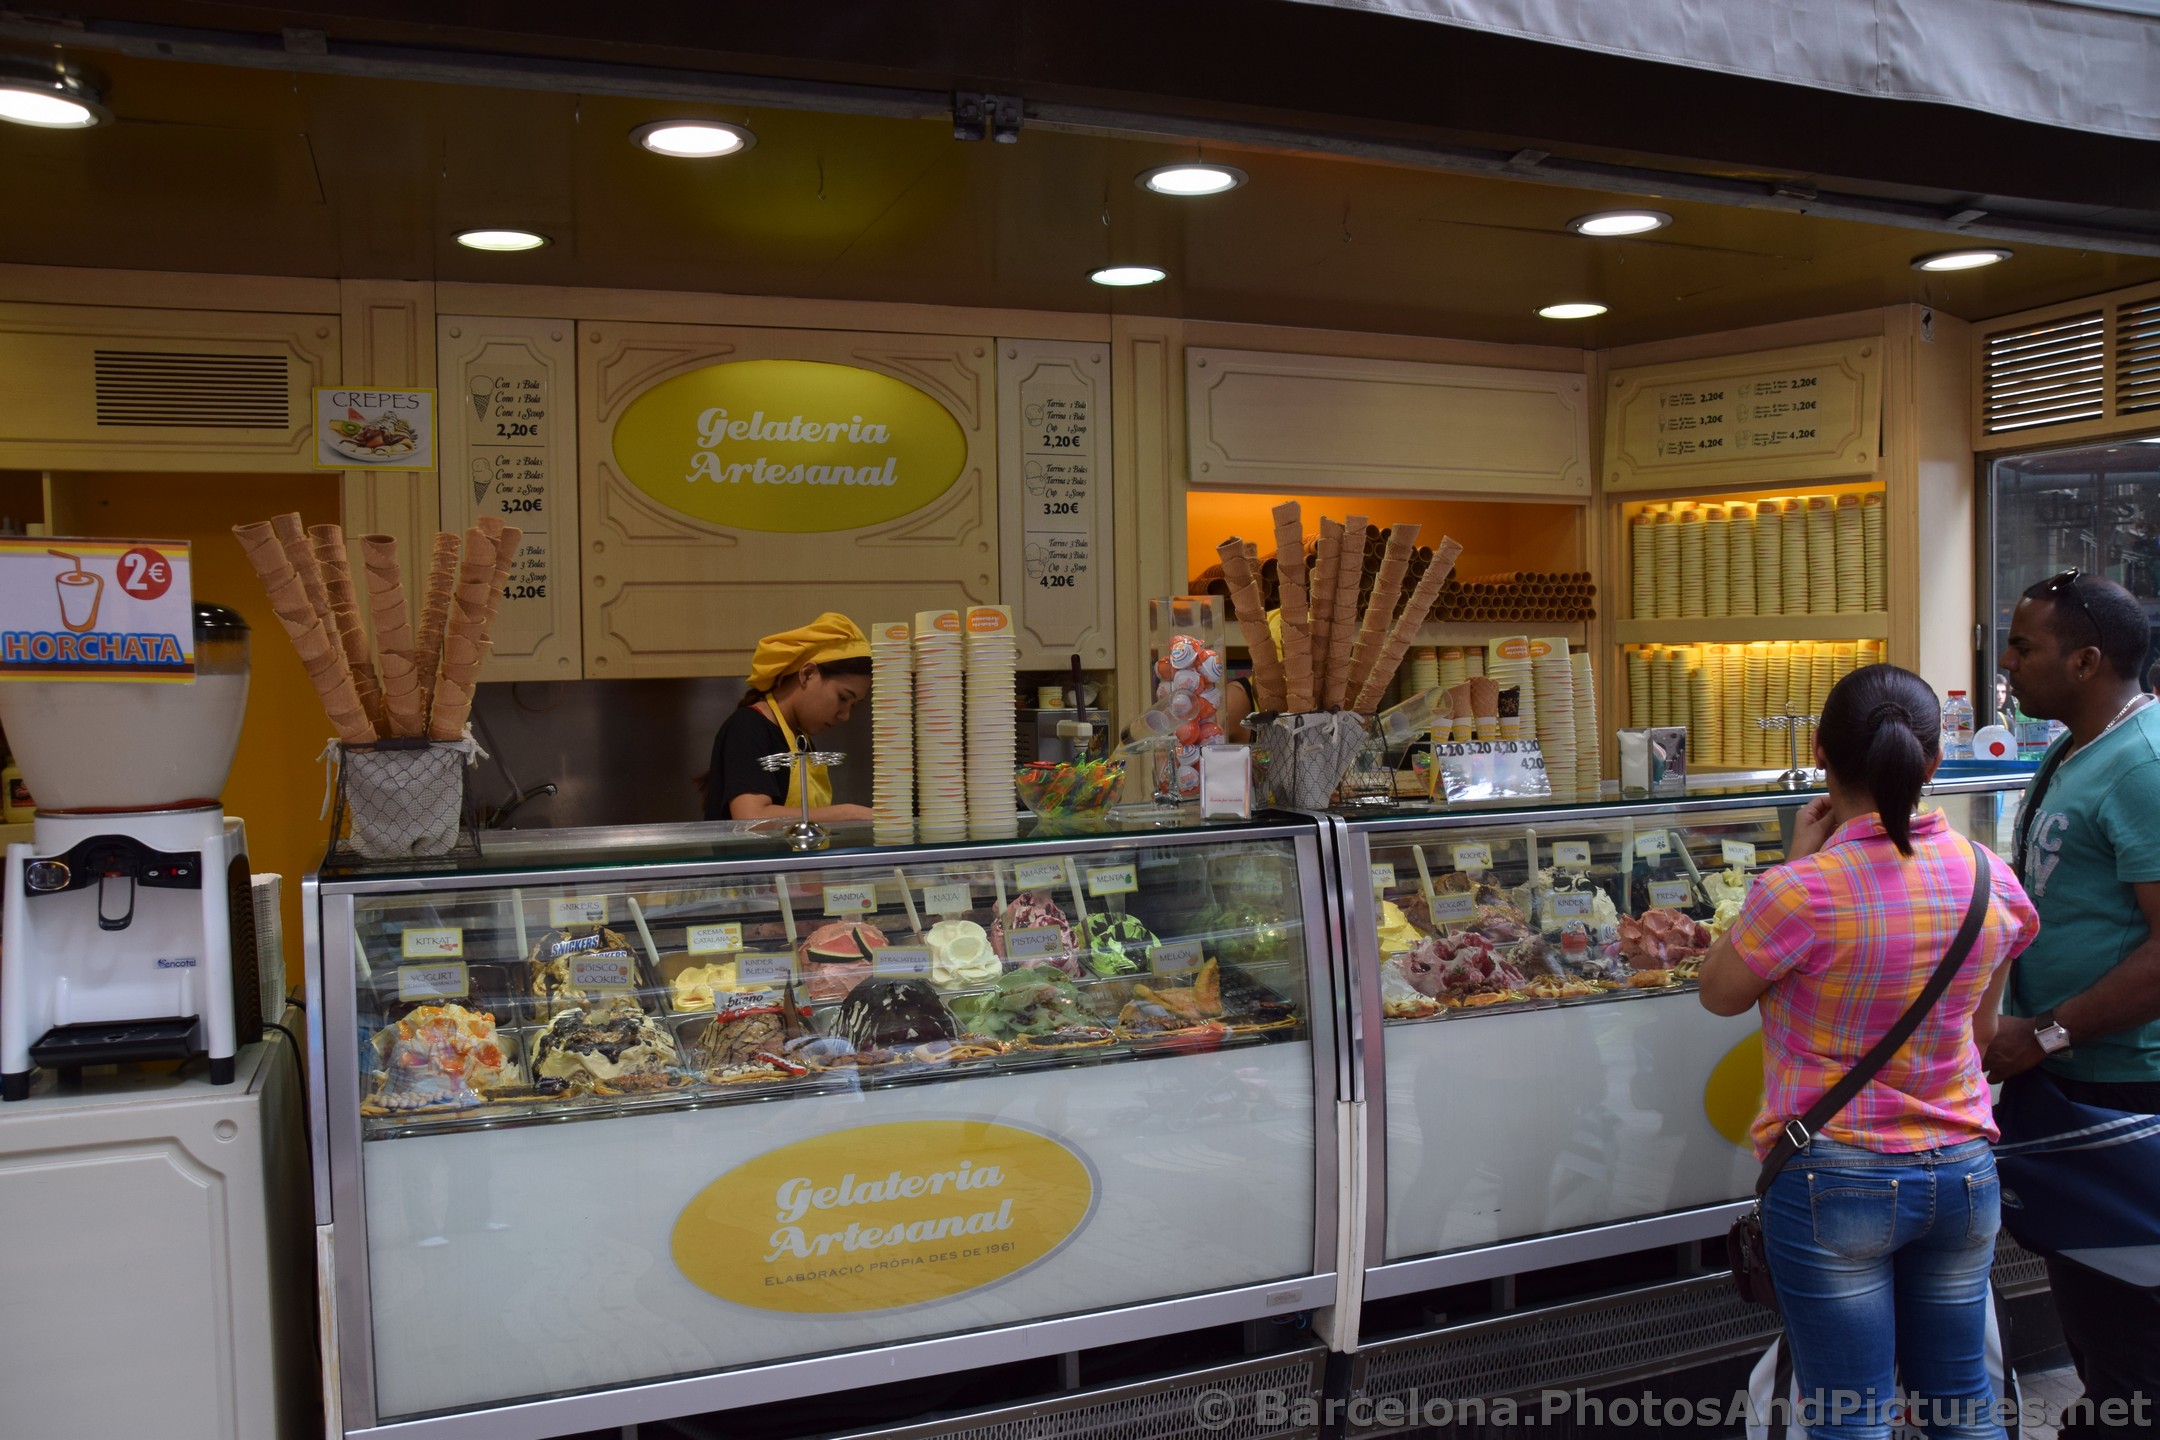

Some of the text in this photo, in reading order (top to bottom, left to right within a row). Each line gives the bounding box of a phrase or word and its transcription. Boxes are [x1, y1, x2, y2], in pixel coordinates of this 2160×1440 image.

[494, 377, 510, 389] Con
[523, 380, 540, 389] Bola
[332, 391, 419, 409] CREPES
[495, 391, 514, 403] Cono
[524, 394, 541, 403] Bola
[495, 405, 514, 417] Cone
[522, 408, 544, 420] Scoop
[496, 423, 538, 440] 2,20€
[697, 407, 890, 448] Gelateria
[1043, 435, 1080, 448] 2,20€
[496, 454, 510, 466] Con
[524, 456, 543, 466] Bolas
[496, 468, 514, 480] Cono
[524, 470, 544, 479] Bolas
[685, 451, 898, 486] Artesanal
[496, 482, 514, 494] Cone
[522, 484, 544, 496] Scoop
[501, 499, 542, 514] 3,20€
[526, 546, 546, 554] Bolas
[527, 560, 546, 568] Bolas
[124, 552, 166, 591] 2€
[526, 572, 546, 584] Scoop
[5, 633, 184, 663] HORCHATA
[1096, 874, 1126, 882] MENTA
[934, 893, 960, 902] NATA
[1558, 899, 1585, 907] KINDER
[560, 902, 600, 910] SNIKERS
[416, 936, 452, 945] KITKAT
[552, 936, 599, 956] SNICKERS
[1012, 934, 1058, 946] PISTACHO
[410, 972, 454, 982] YOGURT
[577, 975, 627, 984] COOKIES
[727, 995, 763, 1007] bueno
[775, 1160, 1005, 1224] Gelateria
[763, 1198, 1015, 1263] Artesanal
[869, 1256, 924, 1272] PRÒPIA
[929, 1251, 957, 1263] DES
[962, 1248, 981, 1258] DE
[986, 1242, 1015, 1254] 1961
